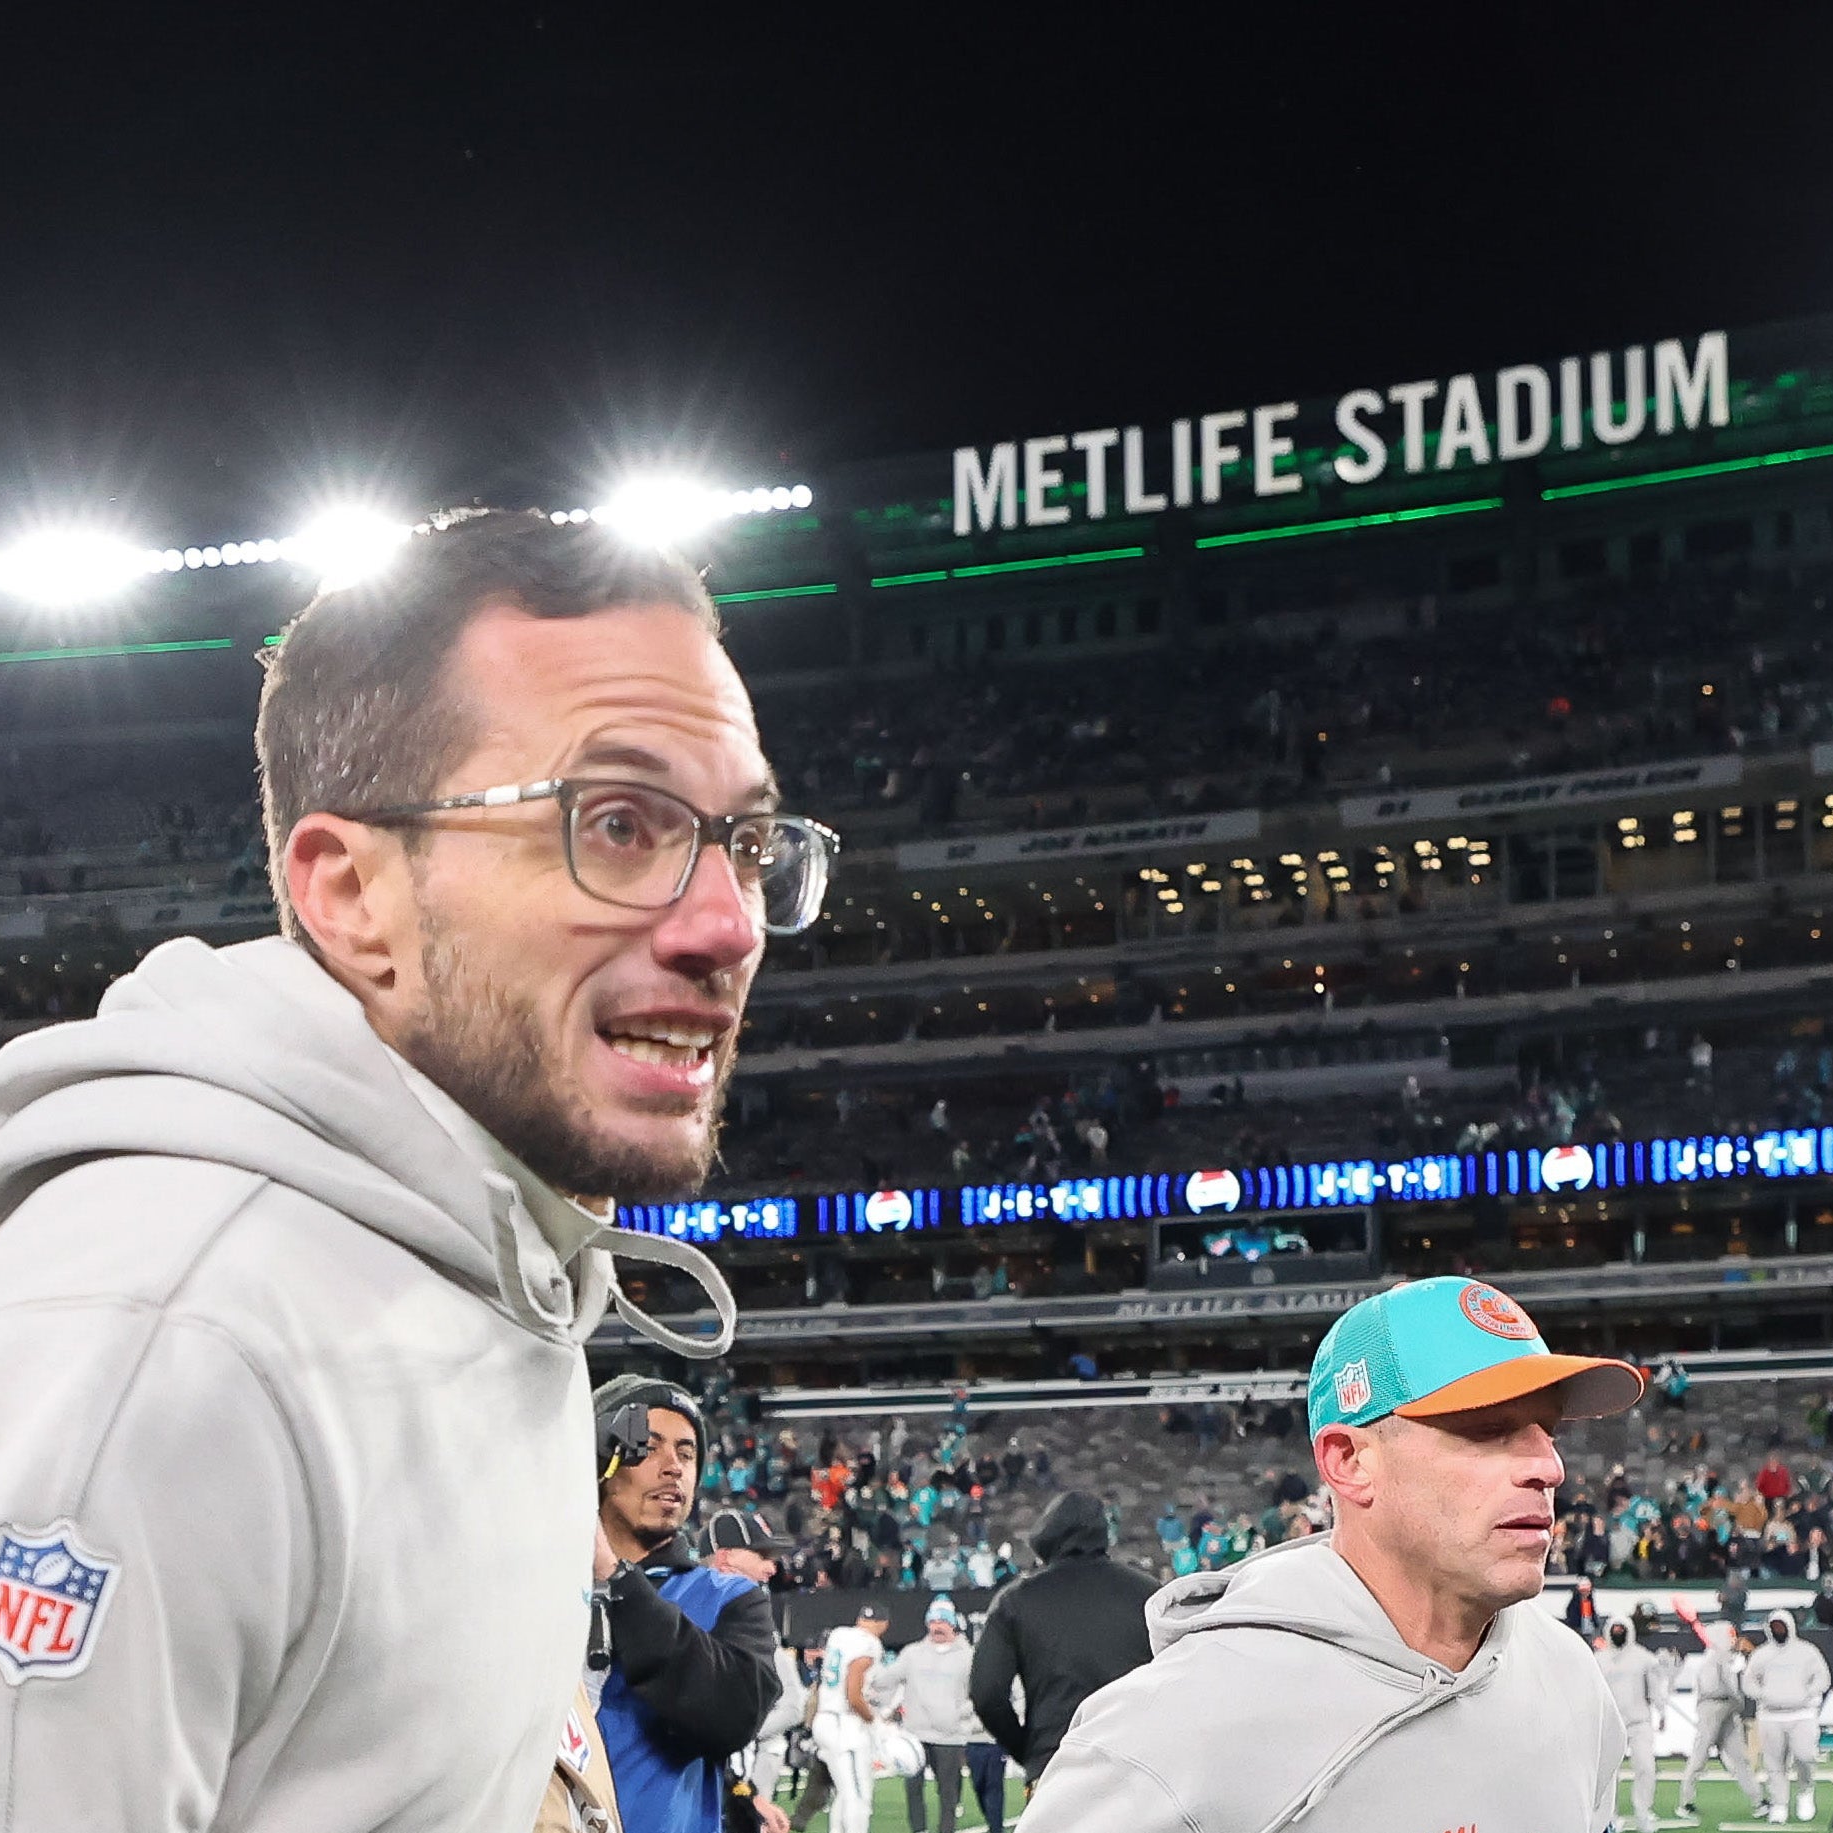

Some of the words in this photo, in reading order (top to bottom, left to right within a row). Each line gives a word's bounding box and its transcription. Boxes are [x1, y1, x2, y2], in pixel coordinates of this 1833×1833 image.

[953, 402, 1303, 537] METLIFE
[1333, 330, 1729, 485] STADIUM
[1341, 1382, 1366, 1408] NFL
